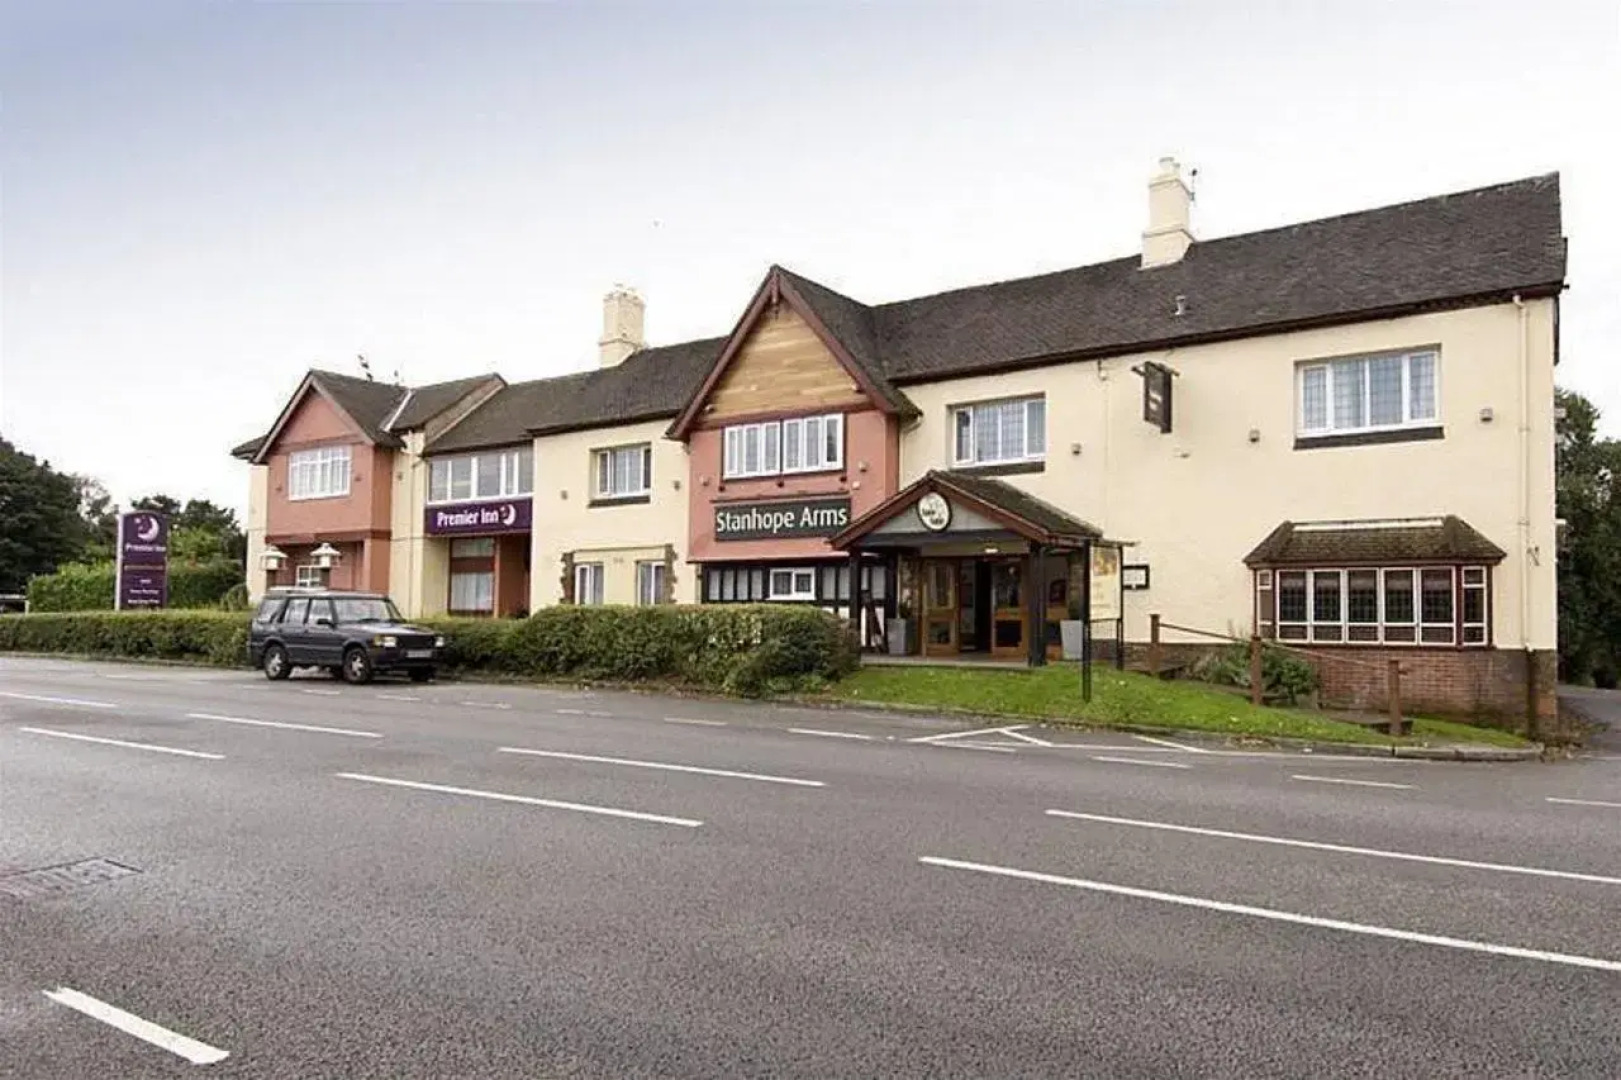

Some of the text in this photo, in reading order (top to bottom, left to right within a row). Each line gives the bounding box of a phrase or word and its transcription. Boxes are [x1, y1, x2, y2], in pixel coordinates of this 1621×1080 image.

[436, 508, 499, 527] Premier Inn
[717, 507, 847, 533] Stanhope Arms
